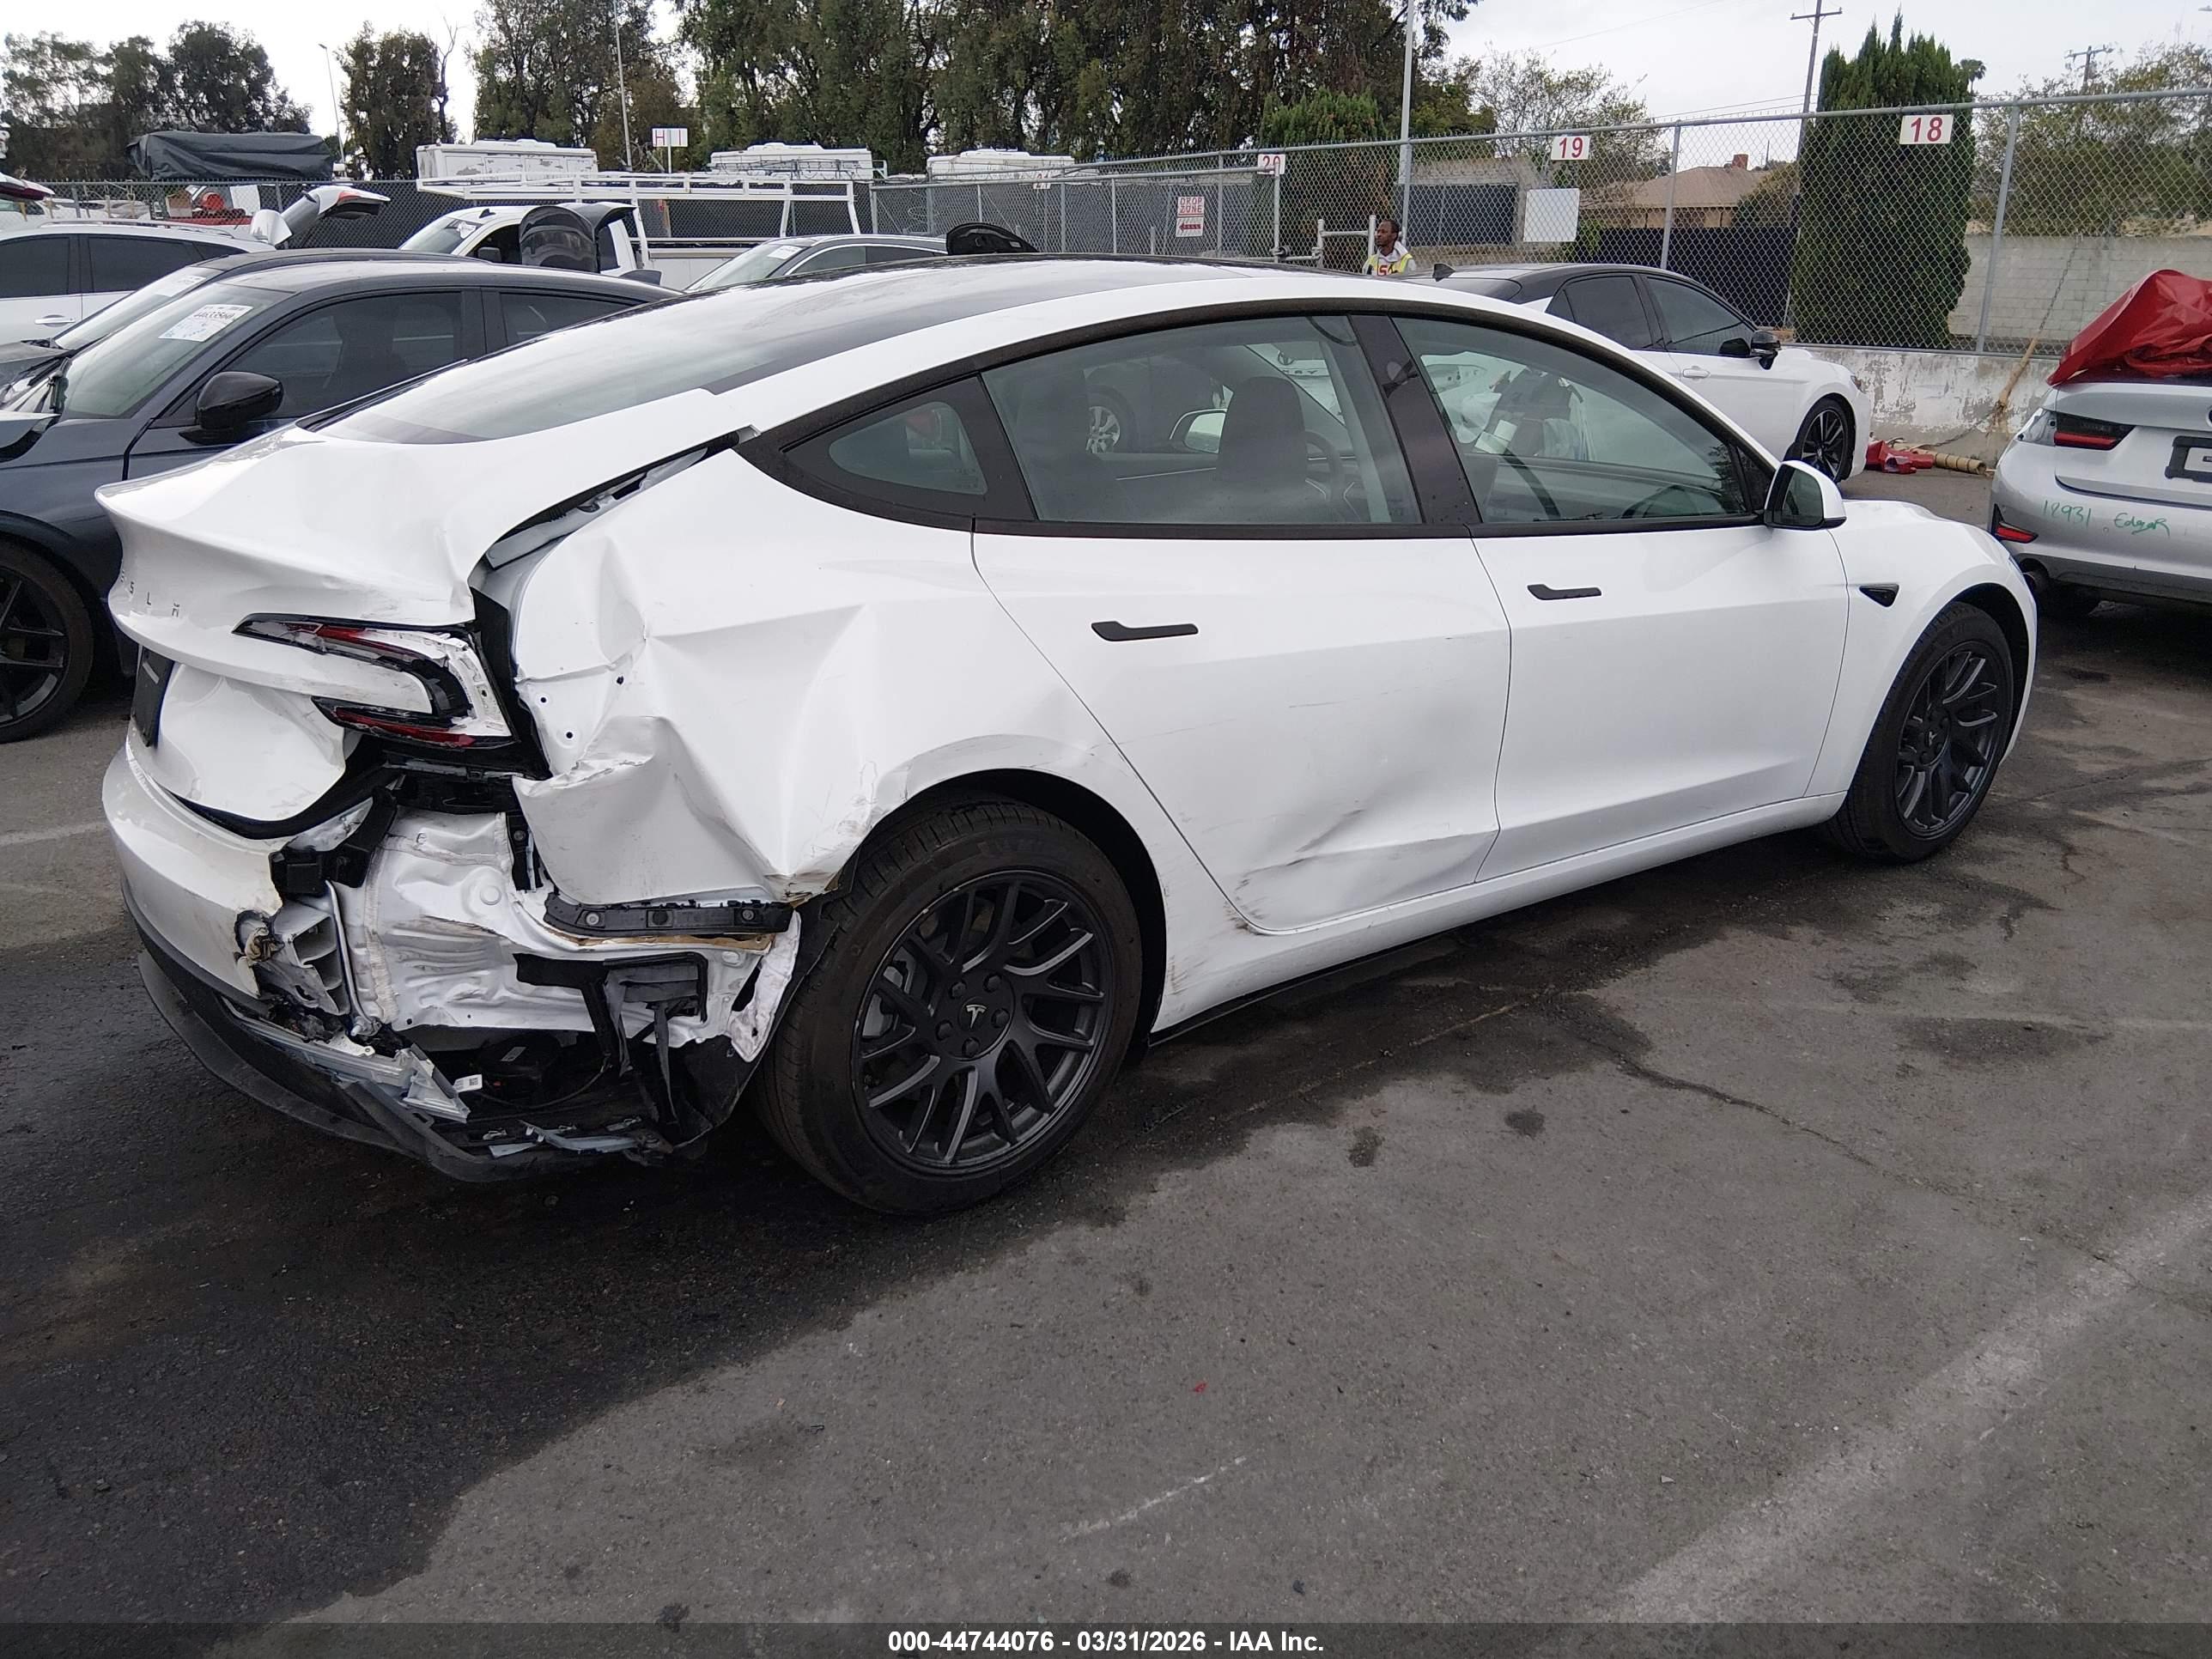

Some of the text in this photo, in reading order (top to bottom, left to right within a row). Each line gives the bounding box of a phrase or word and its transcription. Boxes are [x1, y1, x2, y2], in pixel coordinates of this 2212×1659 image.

[1911, 117, 1943, 143] 18
[1559, 137, 1583, 159] 19
[1262, 155, 1281, 173] 20
[1180, 197, 1203, 205] DROP
[1180, 205, 1203, 214] ZONE
